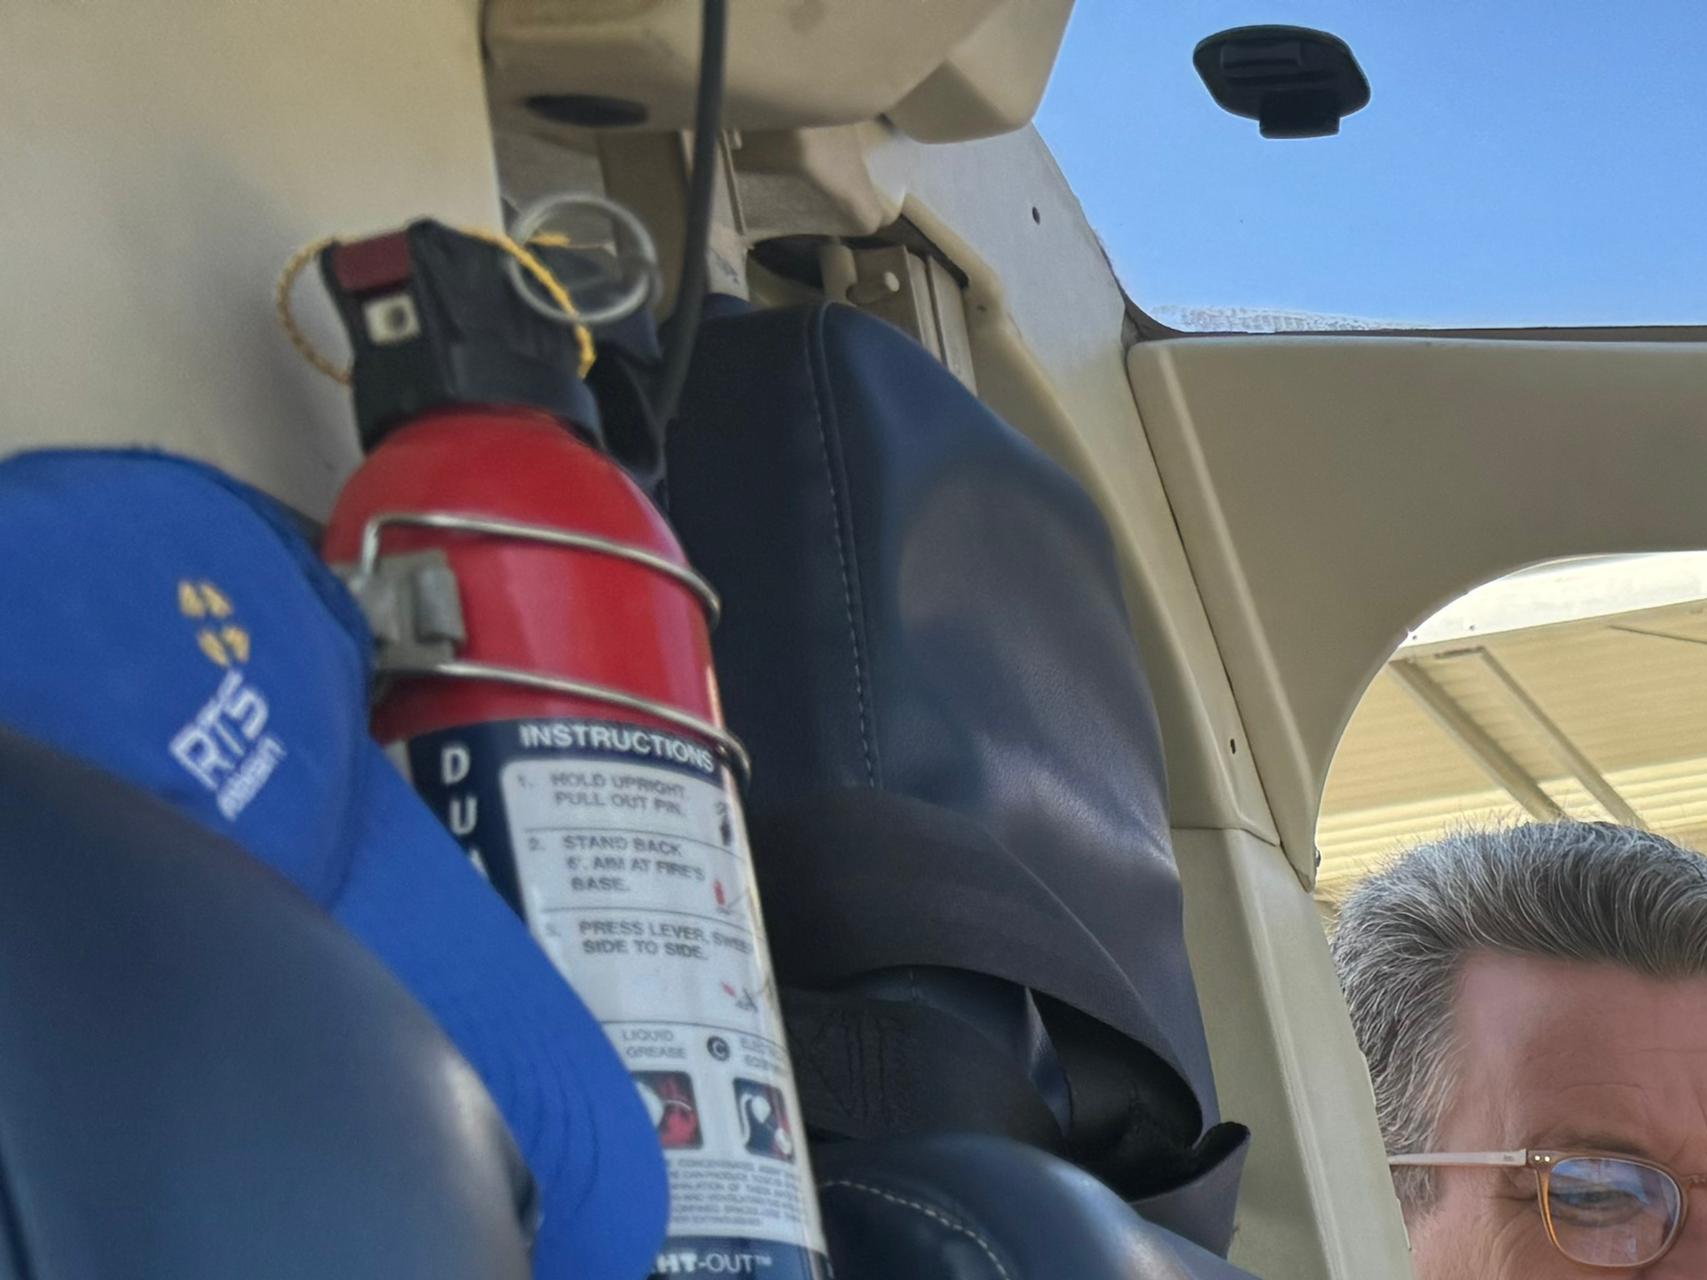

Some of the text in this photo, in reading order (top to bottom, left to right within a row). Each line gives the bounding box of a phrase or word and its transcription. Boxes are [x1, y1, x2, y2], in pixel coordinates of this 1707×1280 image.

[518, 724, 715, 773] INSTRUCTIONS
[551, 773, 606, 788] HOLD
[555, 791, 606, 808] PULL
[611, 793, 649, 812] OUT
[561, 834, 628, 850] STAND
[632, 838, 684, 857] BACK
[630, 860, 650, 876] AT
[571, 875, 631, 893] BASE.
[578, 919, 644, 937] PRESS
[582, 939, 629, 955] SIDE
[636, 940, 658, 956] TO
[622, 1028, 675, 1043] LIQUID
